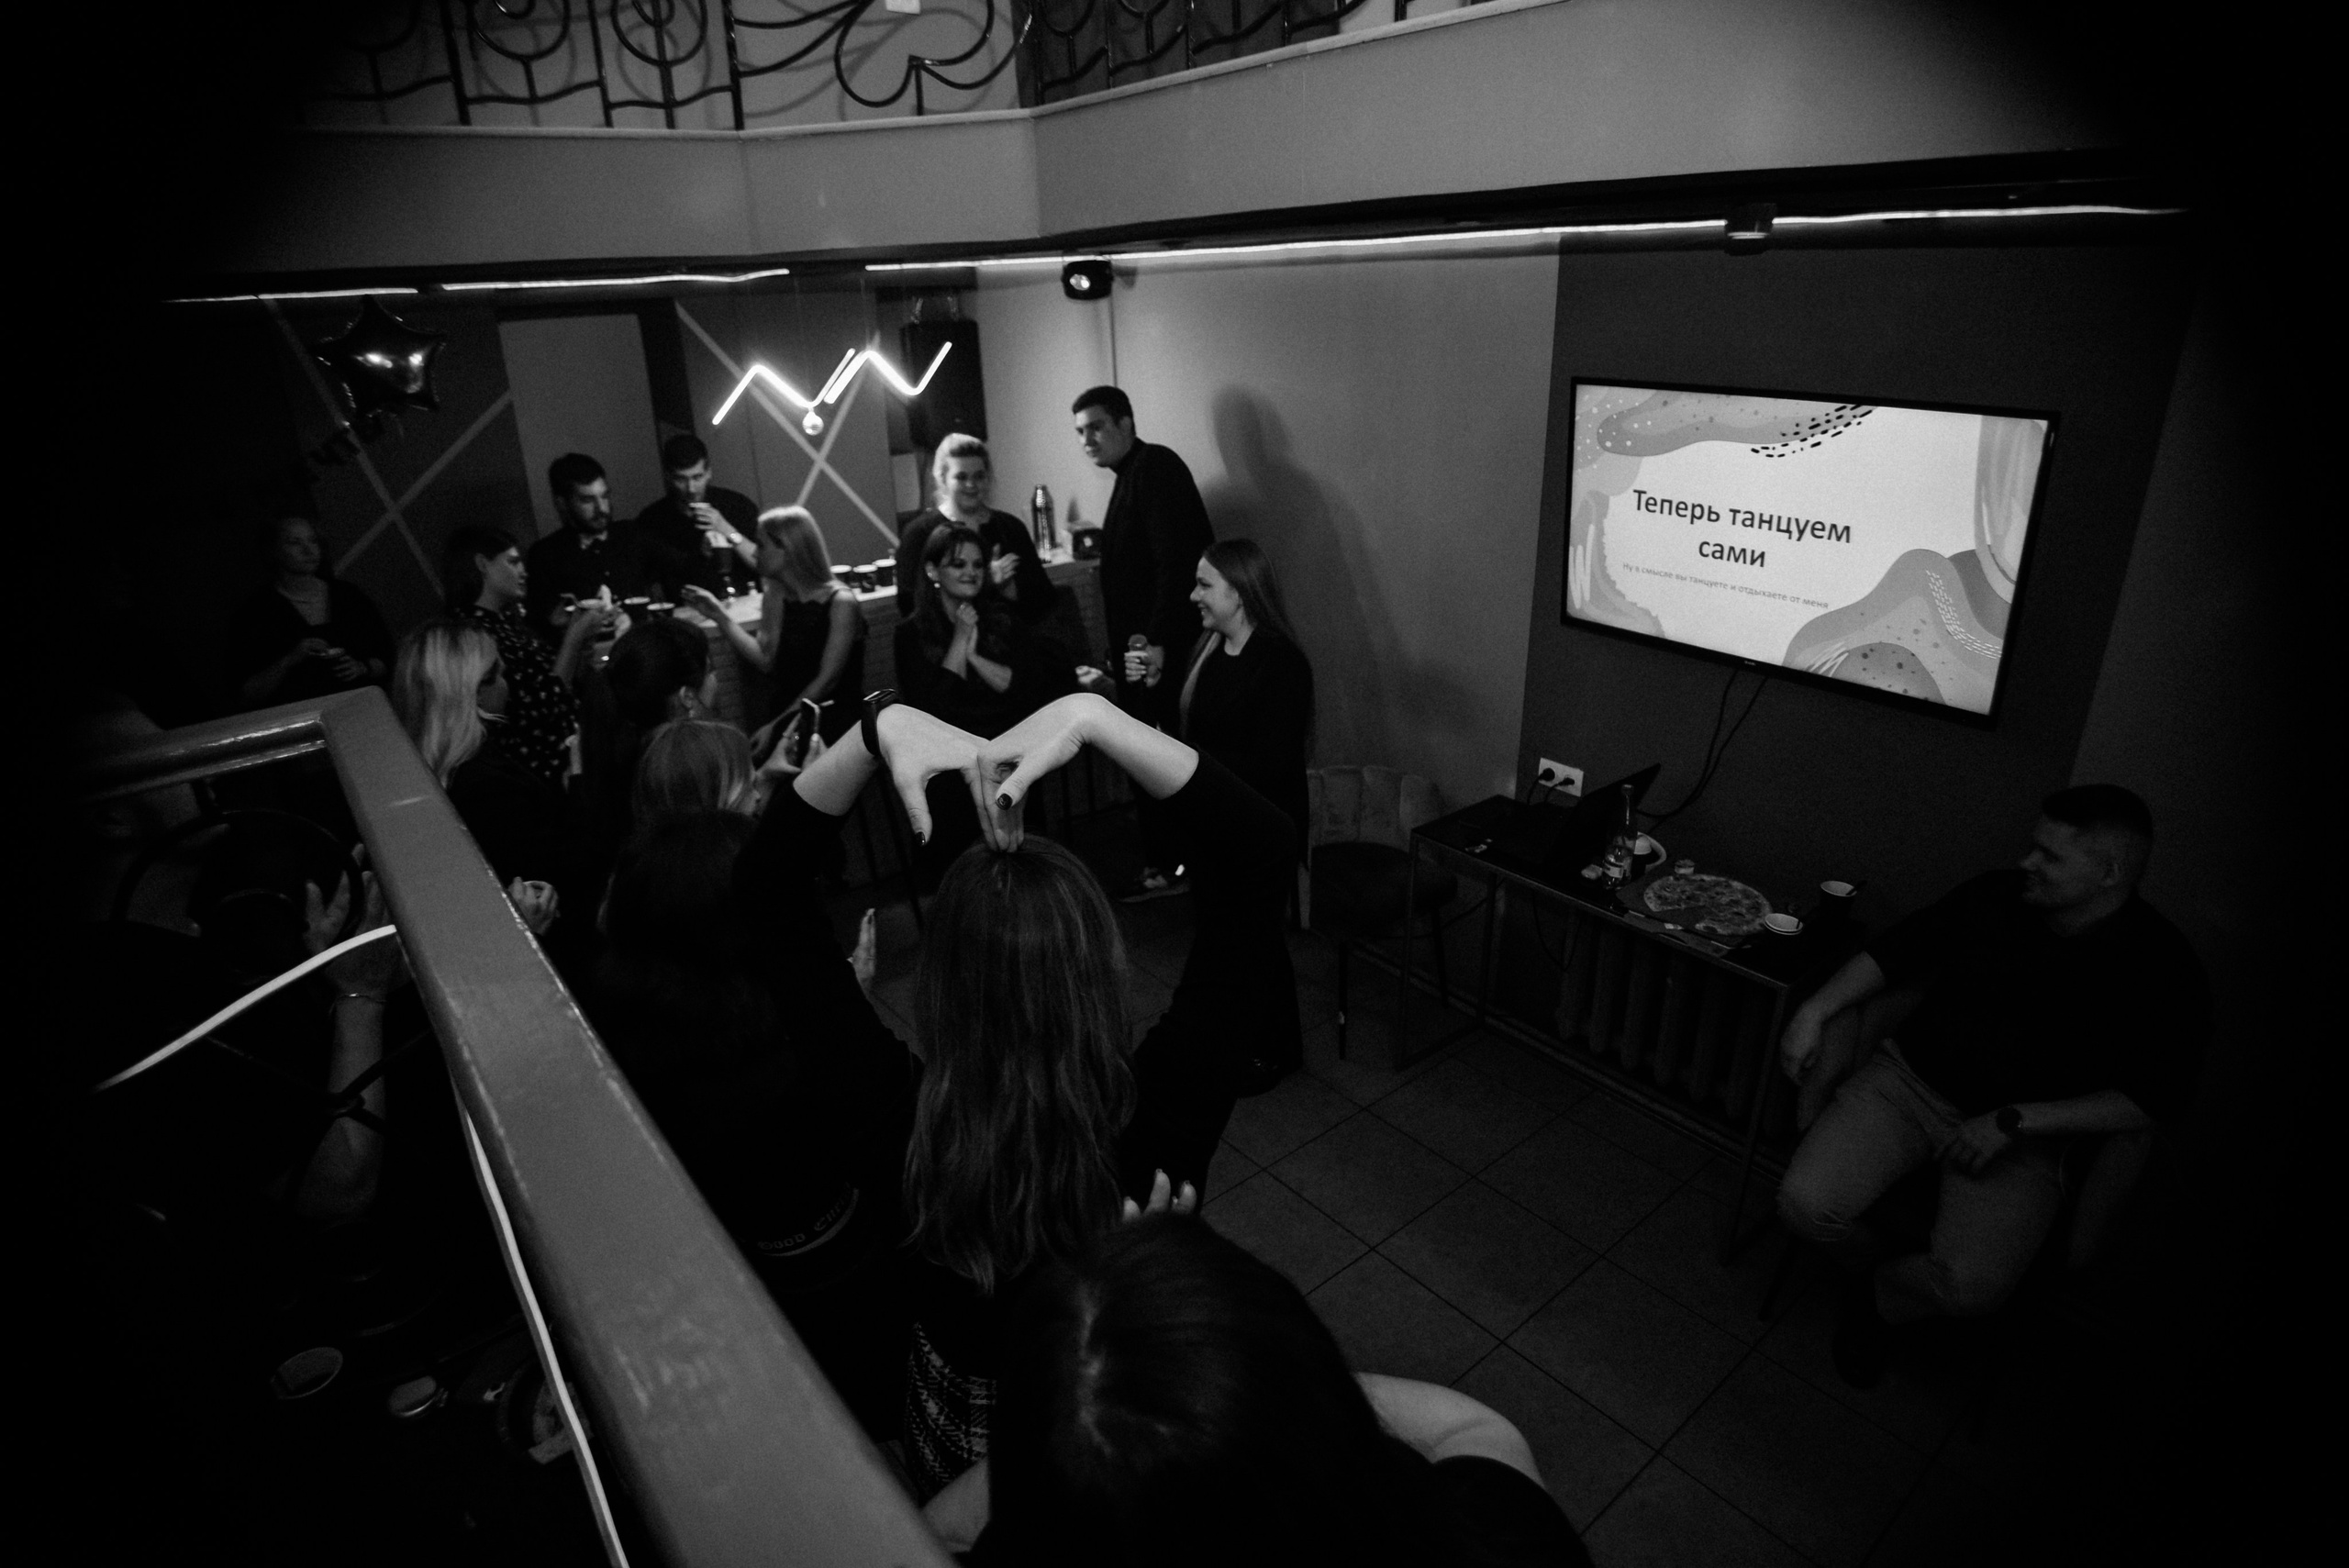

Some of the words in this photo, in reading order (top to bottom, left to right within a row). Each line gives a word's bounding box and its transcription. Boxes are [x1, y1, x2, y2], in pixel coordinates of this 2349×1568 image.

[1632, 489, 1720, 525] Теперь
[1729, 507, 1851, 544] танцуем
[1698, 540, 1766, 568] сами
[1623, 562, 1633, 573] Ну
[1642, 567, 1674, 579] смысле
[1675, 573, 1687, 582] вы
[1689, 576, 1729, 589] танцуете
[1738, 585, 1788, 602] отдыхаете
[1789, 595, 1800, 604] от
[1802, 598, 1829, 609] меня
